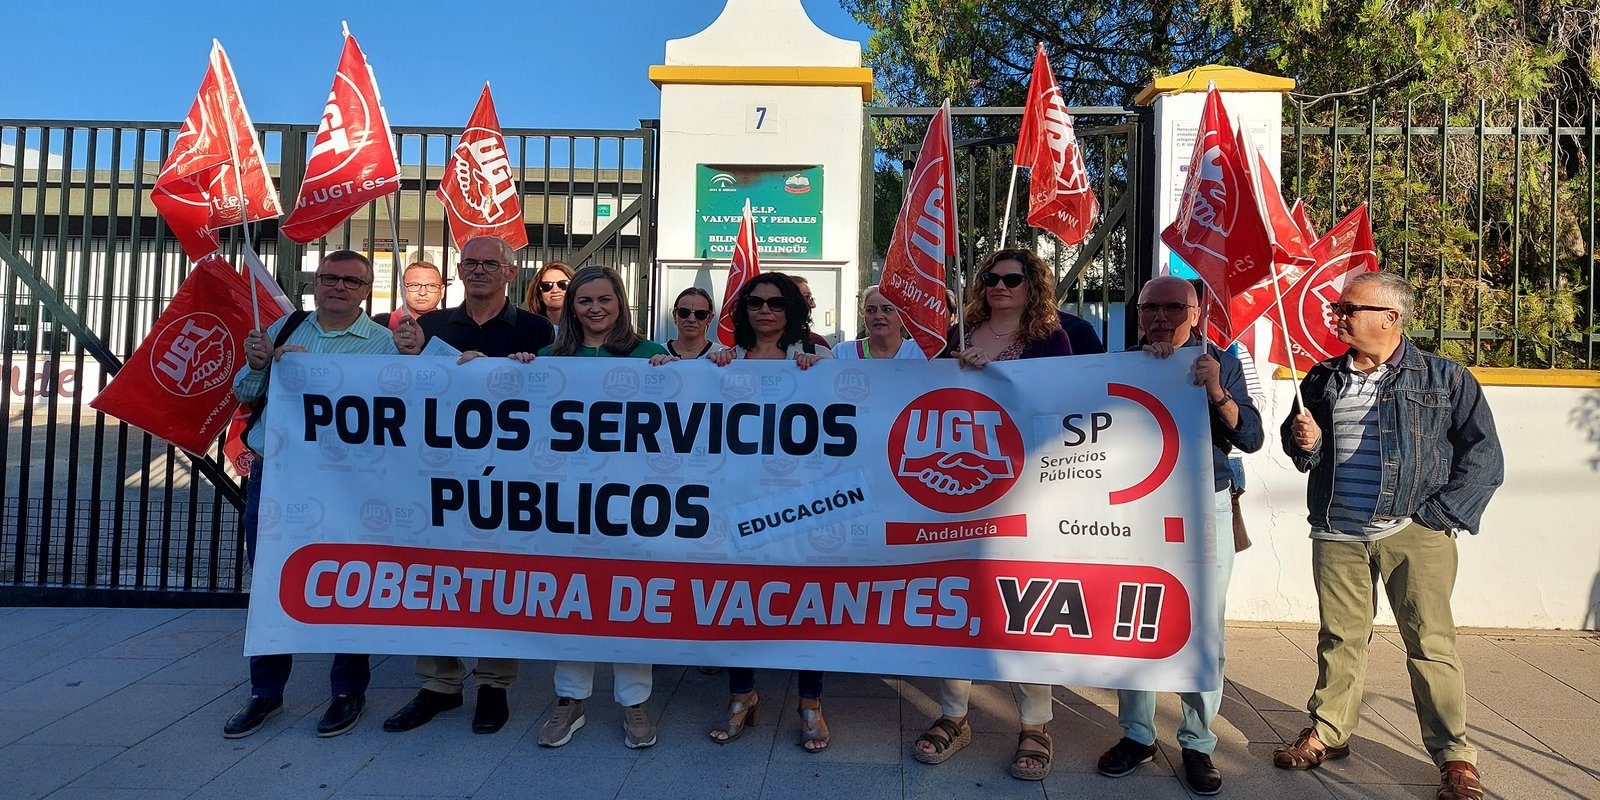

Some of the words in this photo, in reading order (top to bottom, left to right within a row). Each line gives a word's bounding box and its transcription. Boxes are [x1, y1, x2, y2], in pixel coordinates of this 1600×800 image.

[756, 107, 767, 130] 7
[469, 136, 518, 206] UGT
[702, 215, 758, 223] VALVERE
[770, 216, 817, 224] PERALES
[911, 173, 945, 264] UG
[156, 319, 210, 382] UGT
[303, 393, 407, 447] POR
[424, 398, 531, 451] LOS
[549, 400, 858, 457] SERVICIOS
[904, 409, 1004, 458] UGT
[1062, 412, 1112, 447] SP
[1039, 466, 1102, 483] Públicos
[1040, 451, 1106, 468] Servicios
[430, 466, 710, 538] PÚBLICOS
[737, 487, 865, 538] EDUCACIÓN
[915, 522, 998, 543] Andalucía
[1058, 519, 1132, 538] Córdoba
[304, 560, 593, 620] COBERTURA
[608, 575, 676, 624] DE
[690, 576, 981, 637] VACANTES,
[996, 576, 1093, 639] YA
[1112, 582, 1166, 642] !!
